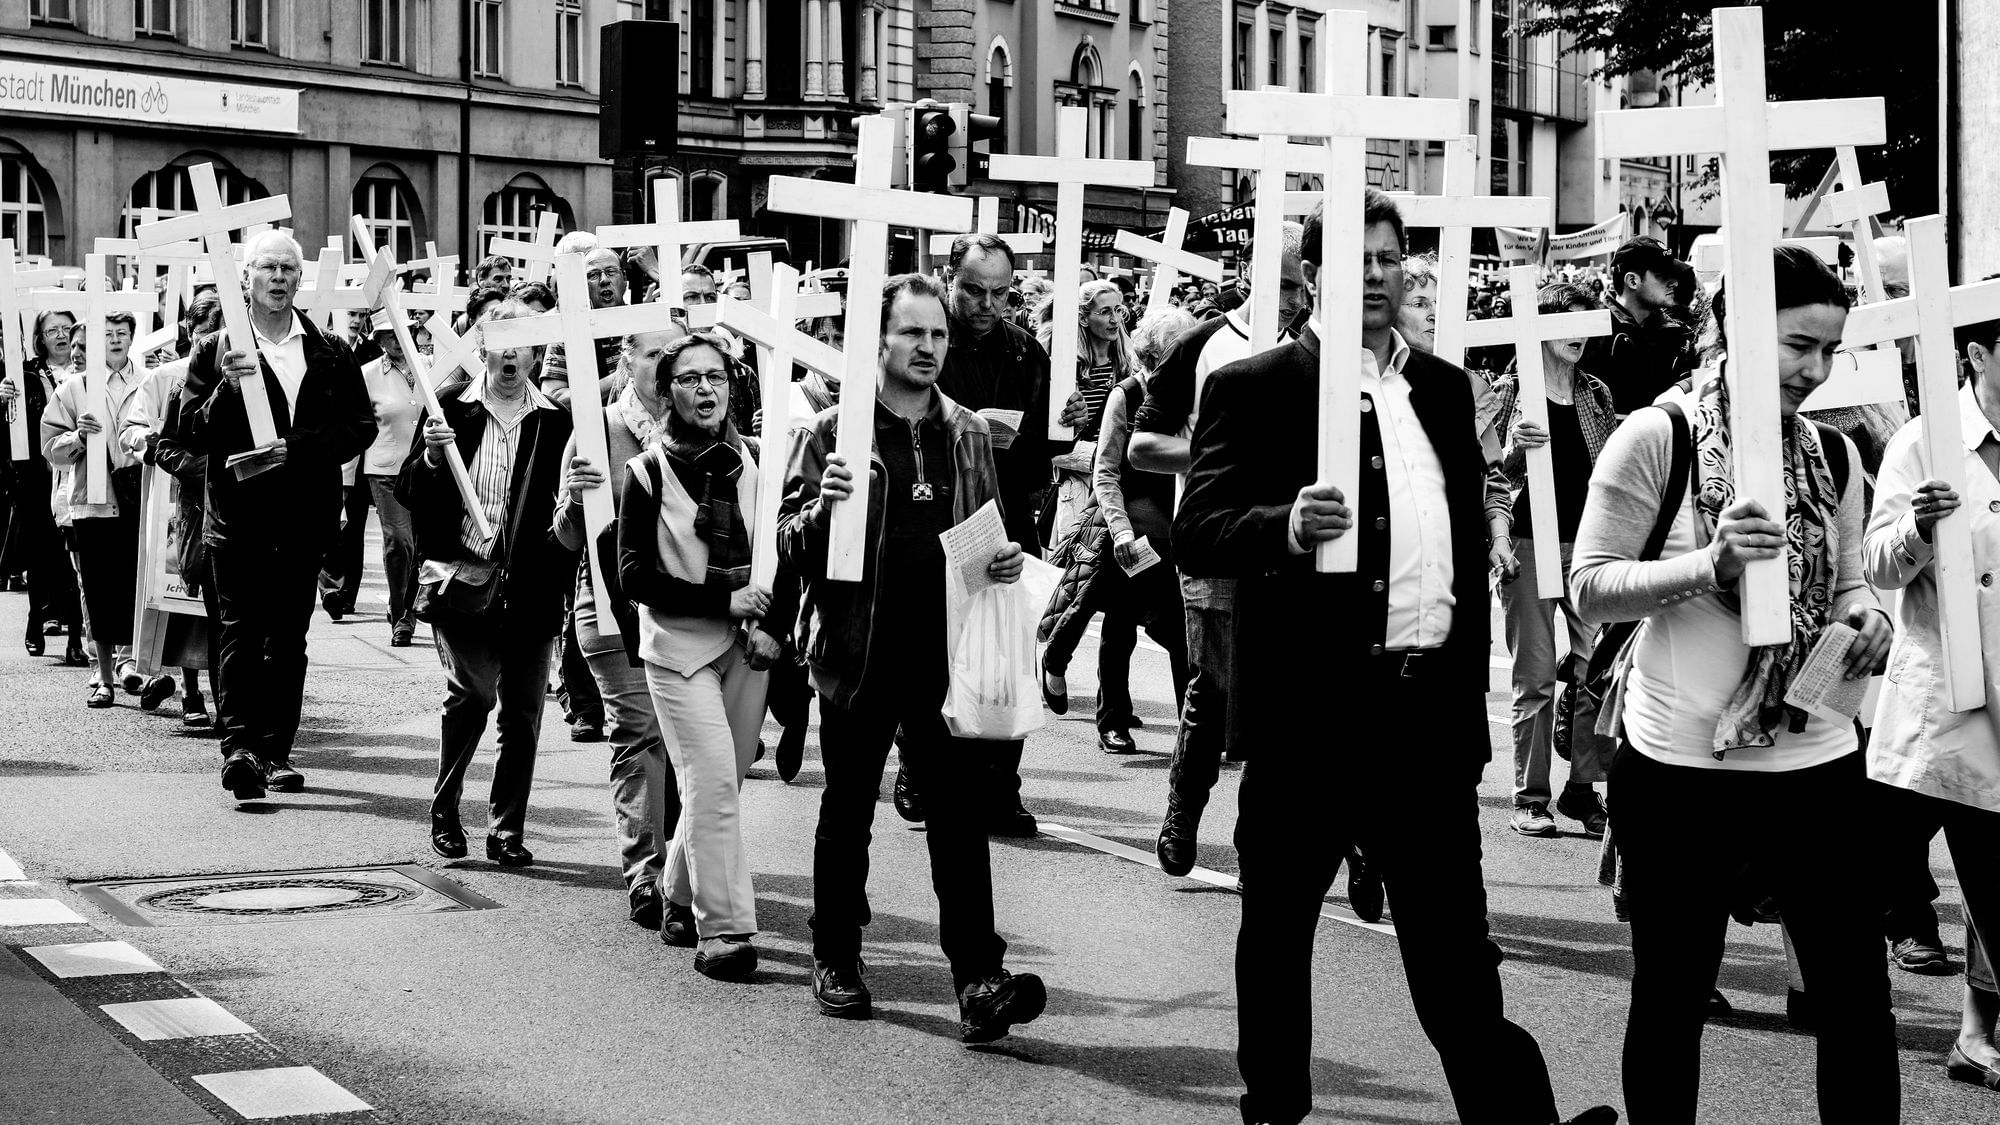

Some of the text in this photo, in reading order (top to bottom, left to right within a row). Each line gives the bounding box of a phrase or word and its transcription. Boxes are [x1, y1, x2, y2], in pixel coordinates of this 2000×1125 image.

[51, 74, 136, 110] München
[1212, 227, 1250, 246] Tag
[1565, 241, 1588, 250] Kinder
